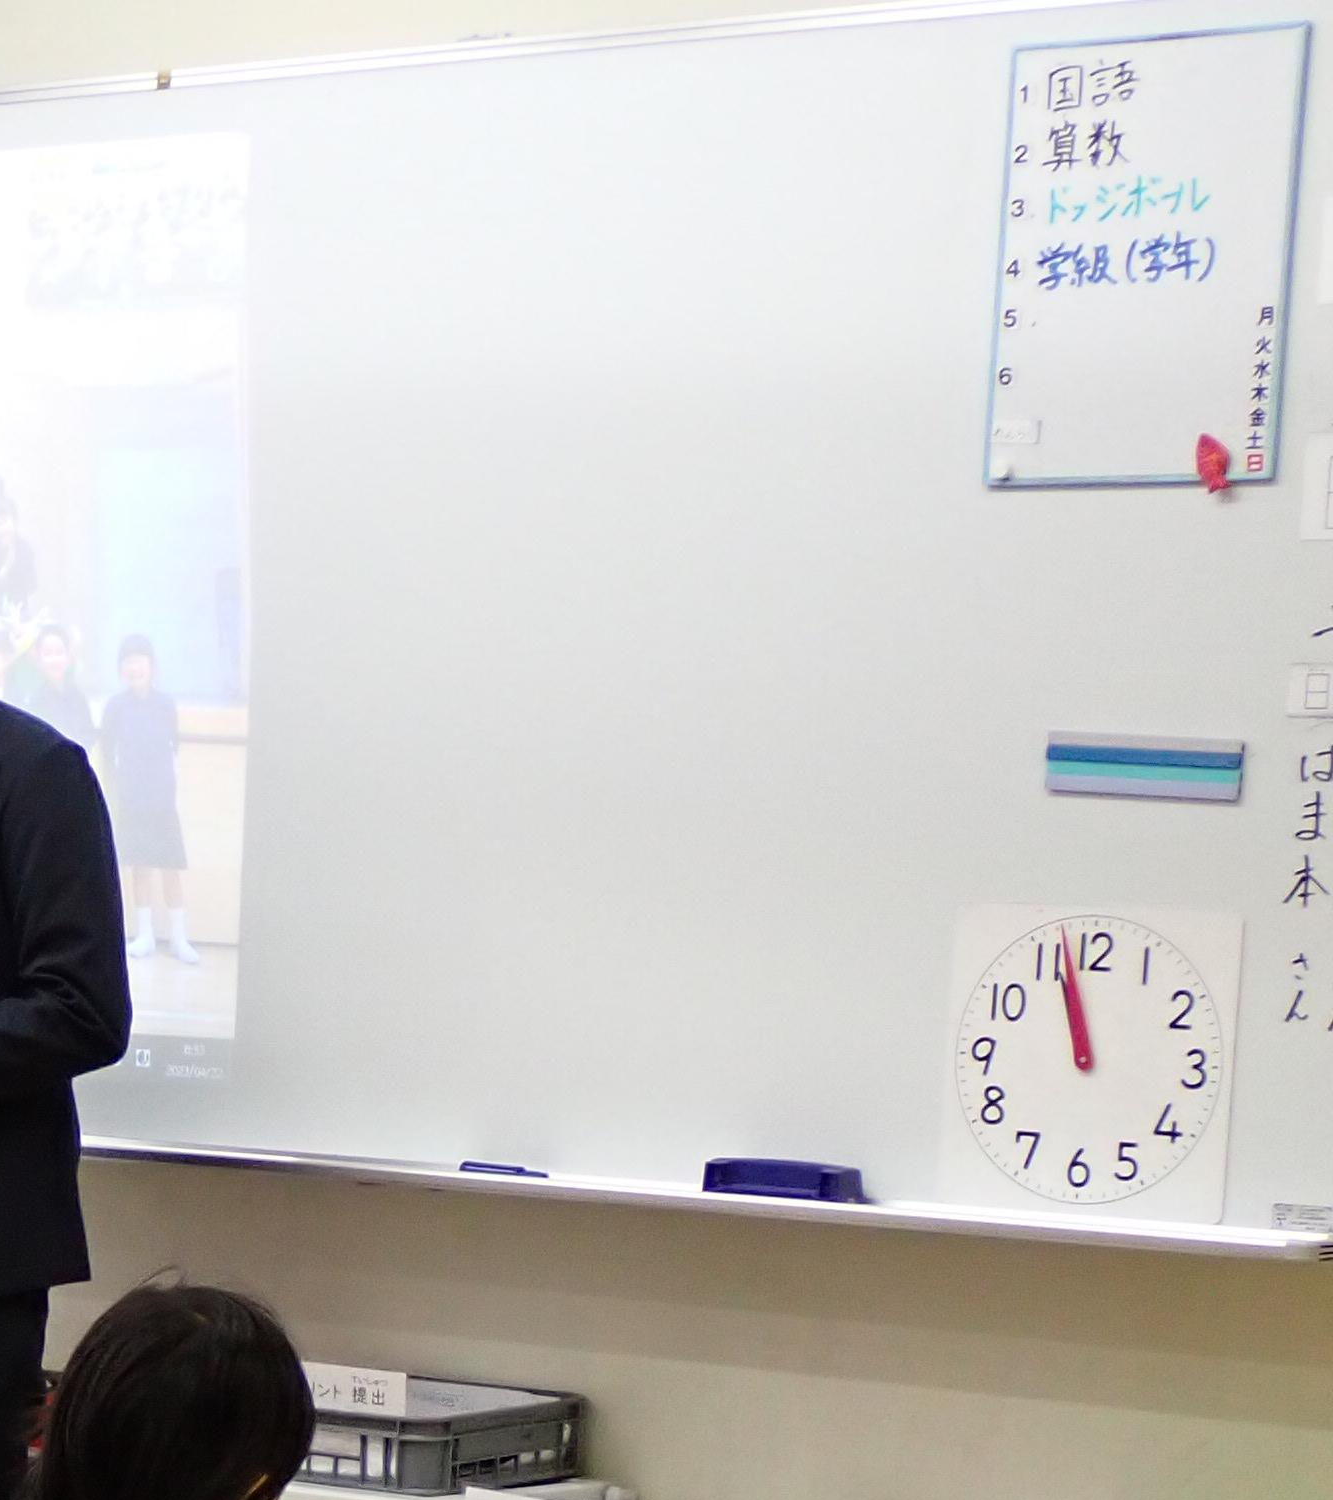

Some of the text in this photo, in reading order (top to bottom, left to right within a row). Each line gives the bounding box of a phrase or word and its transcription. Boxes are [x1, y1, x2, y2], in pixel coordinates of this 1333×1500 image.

[1020, 60, 1140, 111] 1 国語
[1014, 118, 1131, 172] 2 算数
[1011, 175, 1212, 225] 3 ドッジボール
[1006, 230, 1217, 291] 4 学級(学年)
[1004, 308, 1017, 328] 5
[999, 367, 1012, 386] 6
[1035, 942, 1062, 981] 11
[1078, 931, 1113, 972] 12
[1142, 946, 1150, 985] 1
[990, 982, 1027, 1022] 10
[1168, 989, 1195, 1030] 2
[970, 1036, 996, 1076] 9
[1181, 1049, 1208, 1091] 3
[981, 1084, 1006, 1125] 8
[1153, 1103, 1183, 1143] 4
[1015, 1131, 1041, 1169] 7
[1067, 1148, 1091, 1188] 6
[1115, 1142, 1139, 1182] 5
[353, 1386, 384, 1405] 提出
